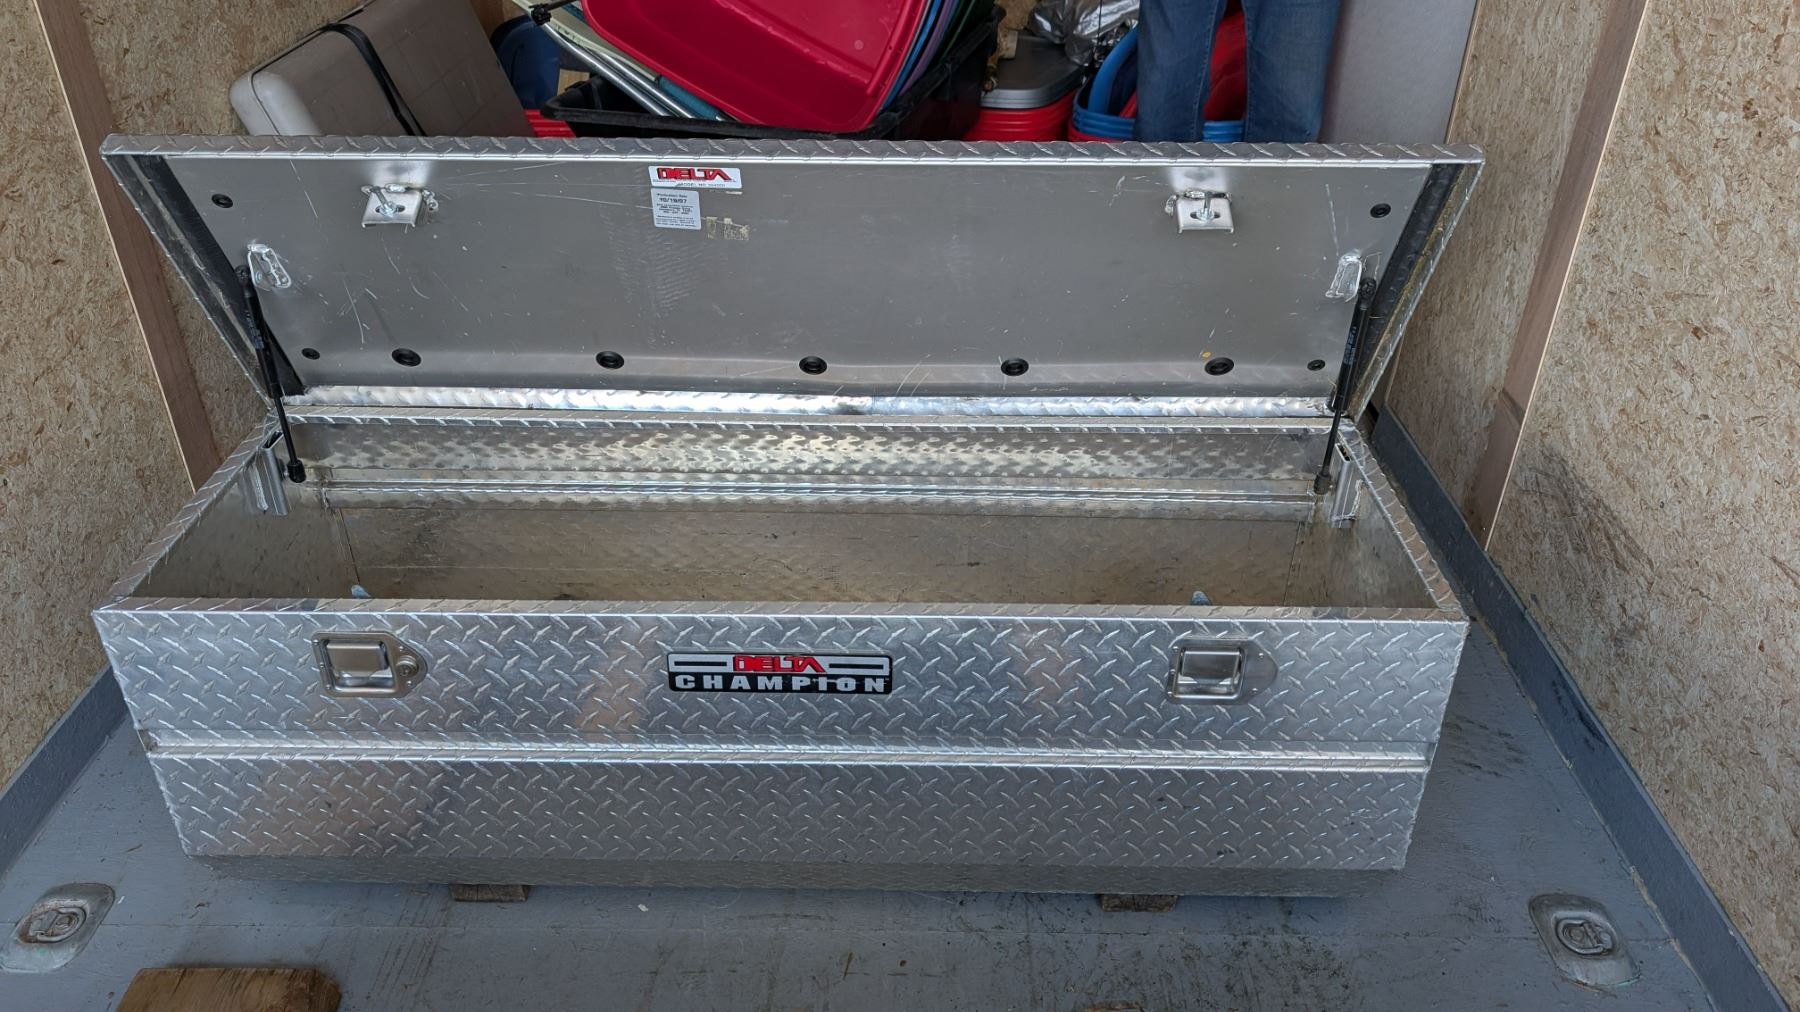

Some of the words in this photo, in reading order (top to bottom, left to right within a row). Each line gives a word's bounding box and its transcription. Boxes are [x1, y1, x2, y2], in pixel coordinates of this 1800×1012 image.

[657, 167, 732, 181] DELTA
[733, 655, 826, 672] DELTA
[675, 674, 885, 693] CHAMPION
